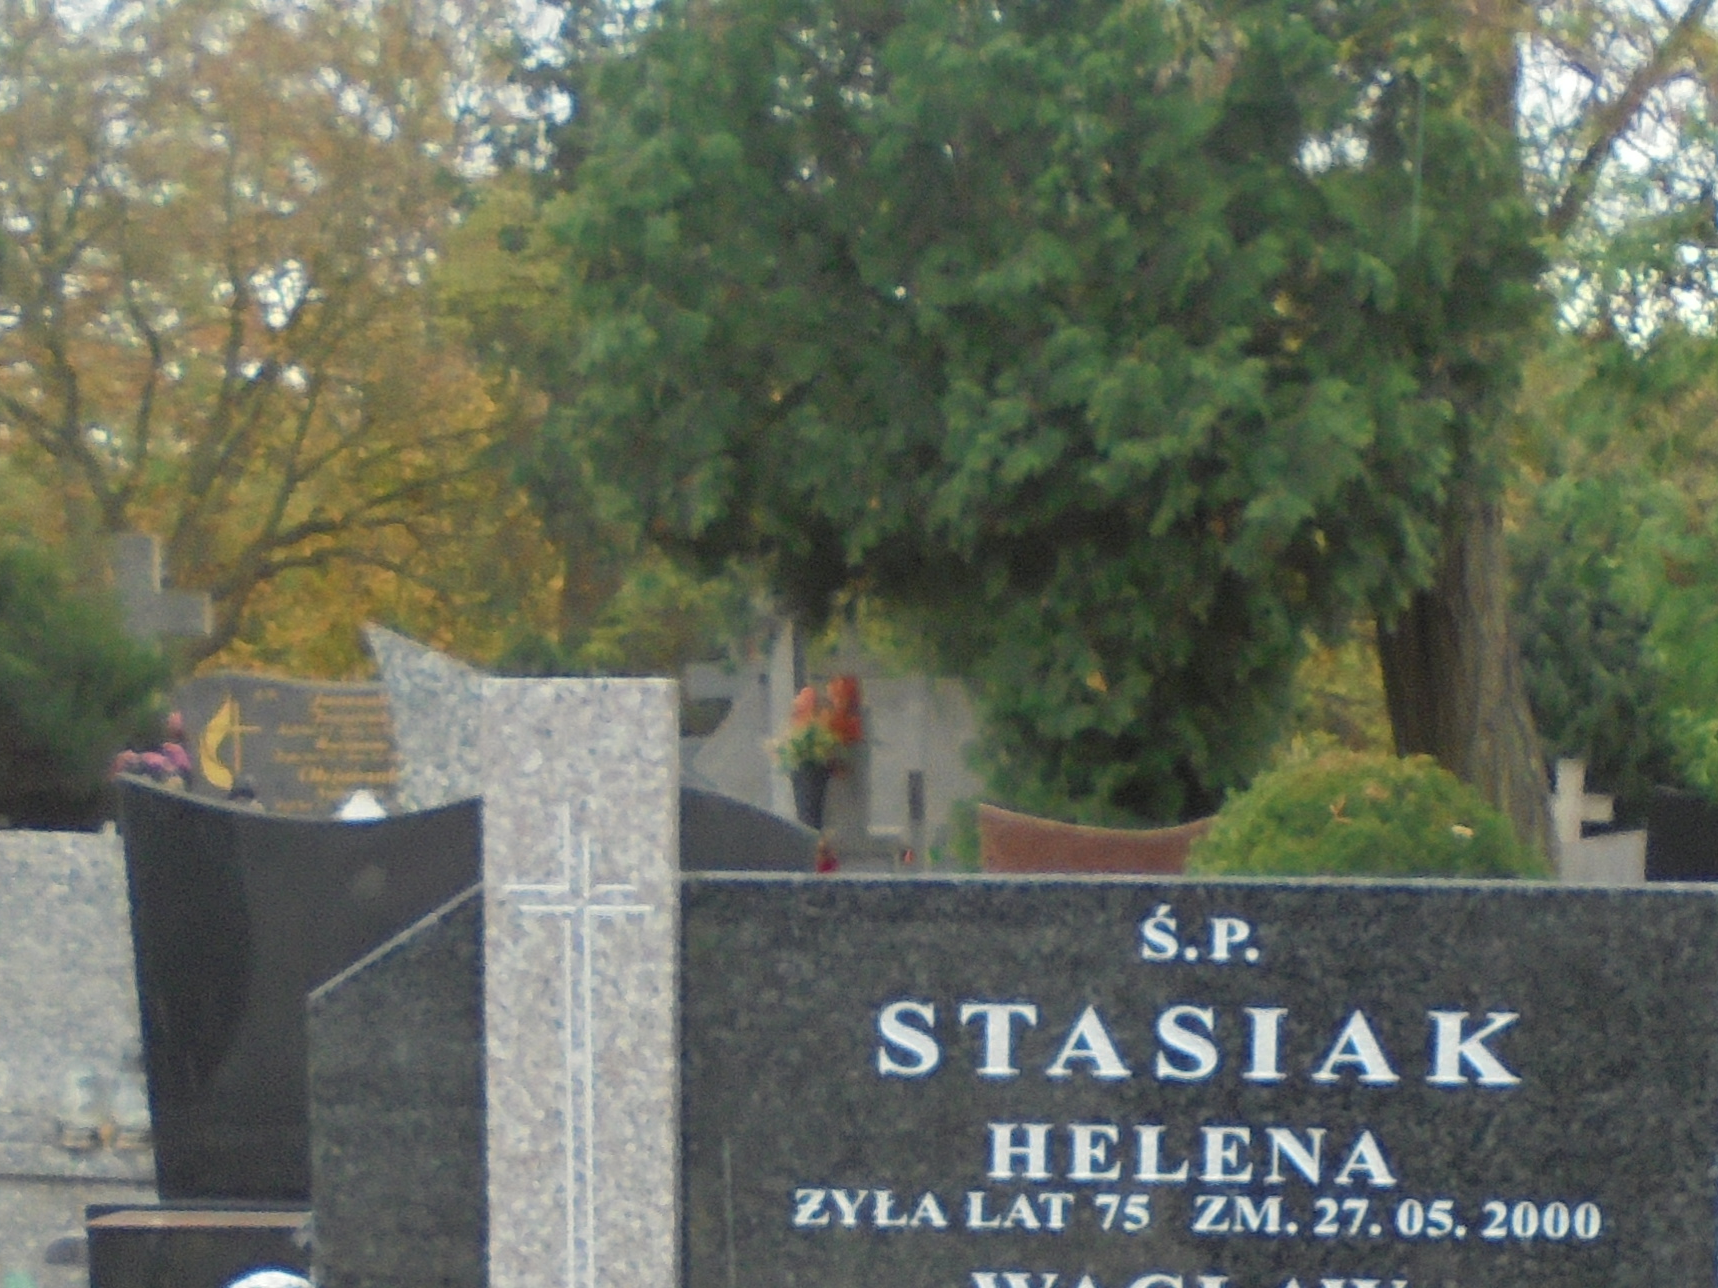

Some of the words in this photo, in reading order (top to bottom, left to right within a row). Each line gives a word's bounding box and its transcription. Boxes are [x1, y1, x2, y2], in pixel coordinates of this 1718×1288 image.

[1140, 904, 1260, 963] Ś.P.
[875, 1000, 1522, 1086] STASIAK
[986, 1122, 1398, 1188] HELENA
[965, 1189, 1076, 1232] LAT
[1094, 1192, 1152, 1233] 75
[1192, 1194, 1300, 1236] ZM.
[1481, 1199, 1603, 1241] 2000
